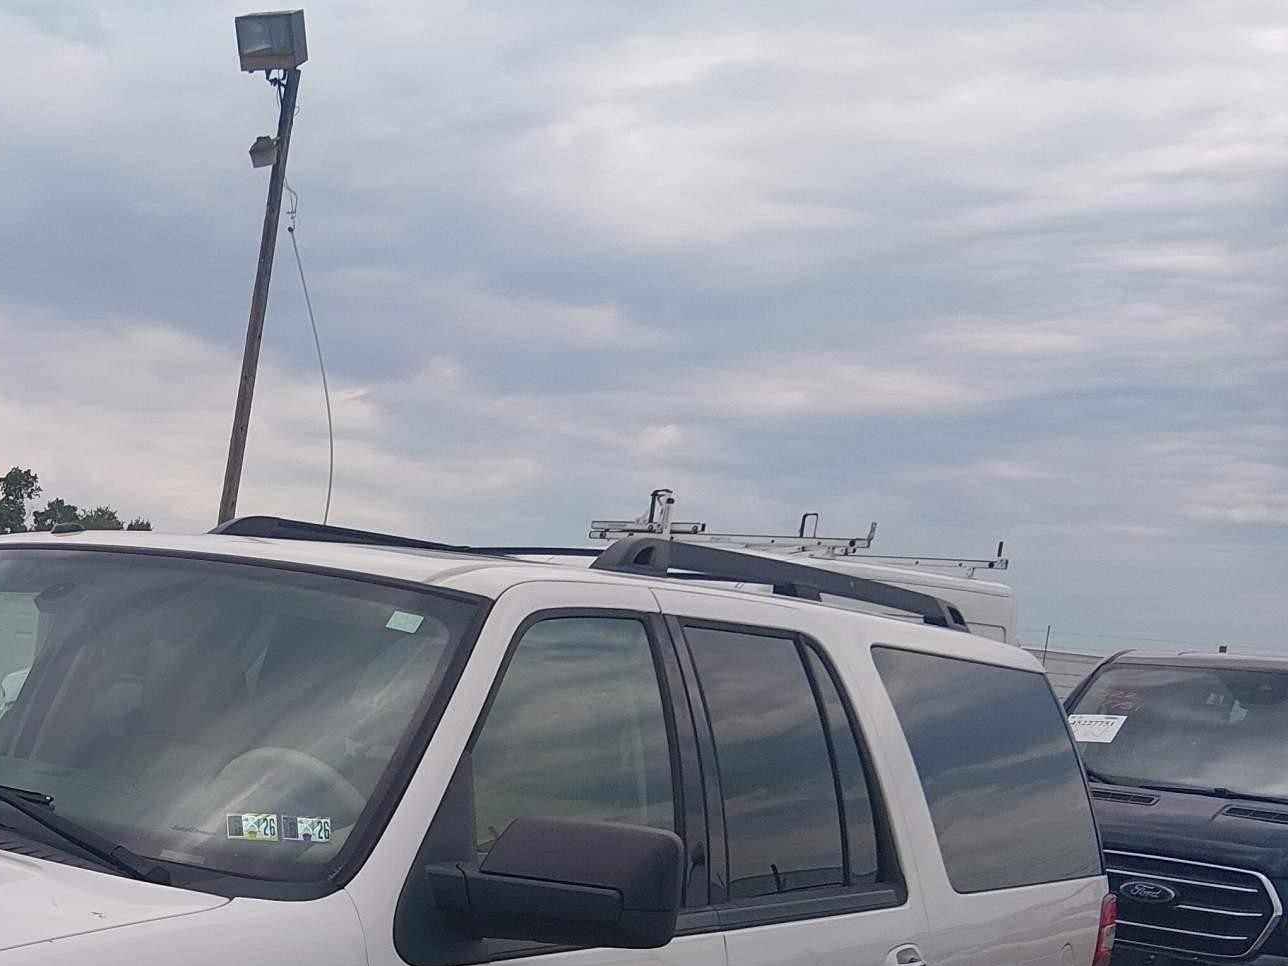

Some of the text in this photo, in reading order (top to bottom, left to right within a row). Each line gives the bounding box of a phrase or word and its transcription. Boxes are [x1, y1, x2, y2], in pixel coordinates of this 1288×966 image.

[263, 818, 276, 837] 26
[317, 820, 330, 840] 26
[1130, 884, 1162, 898] Ford
